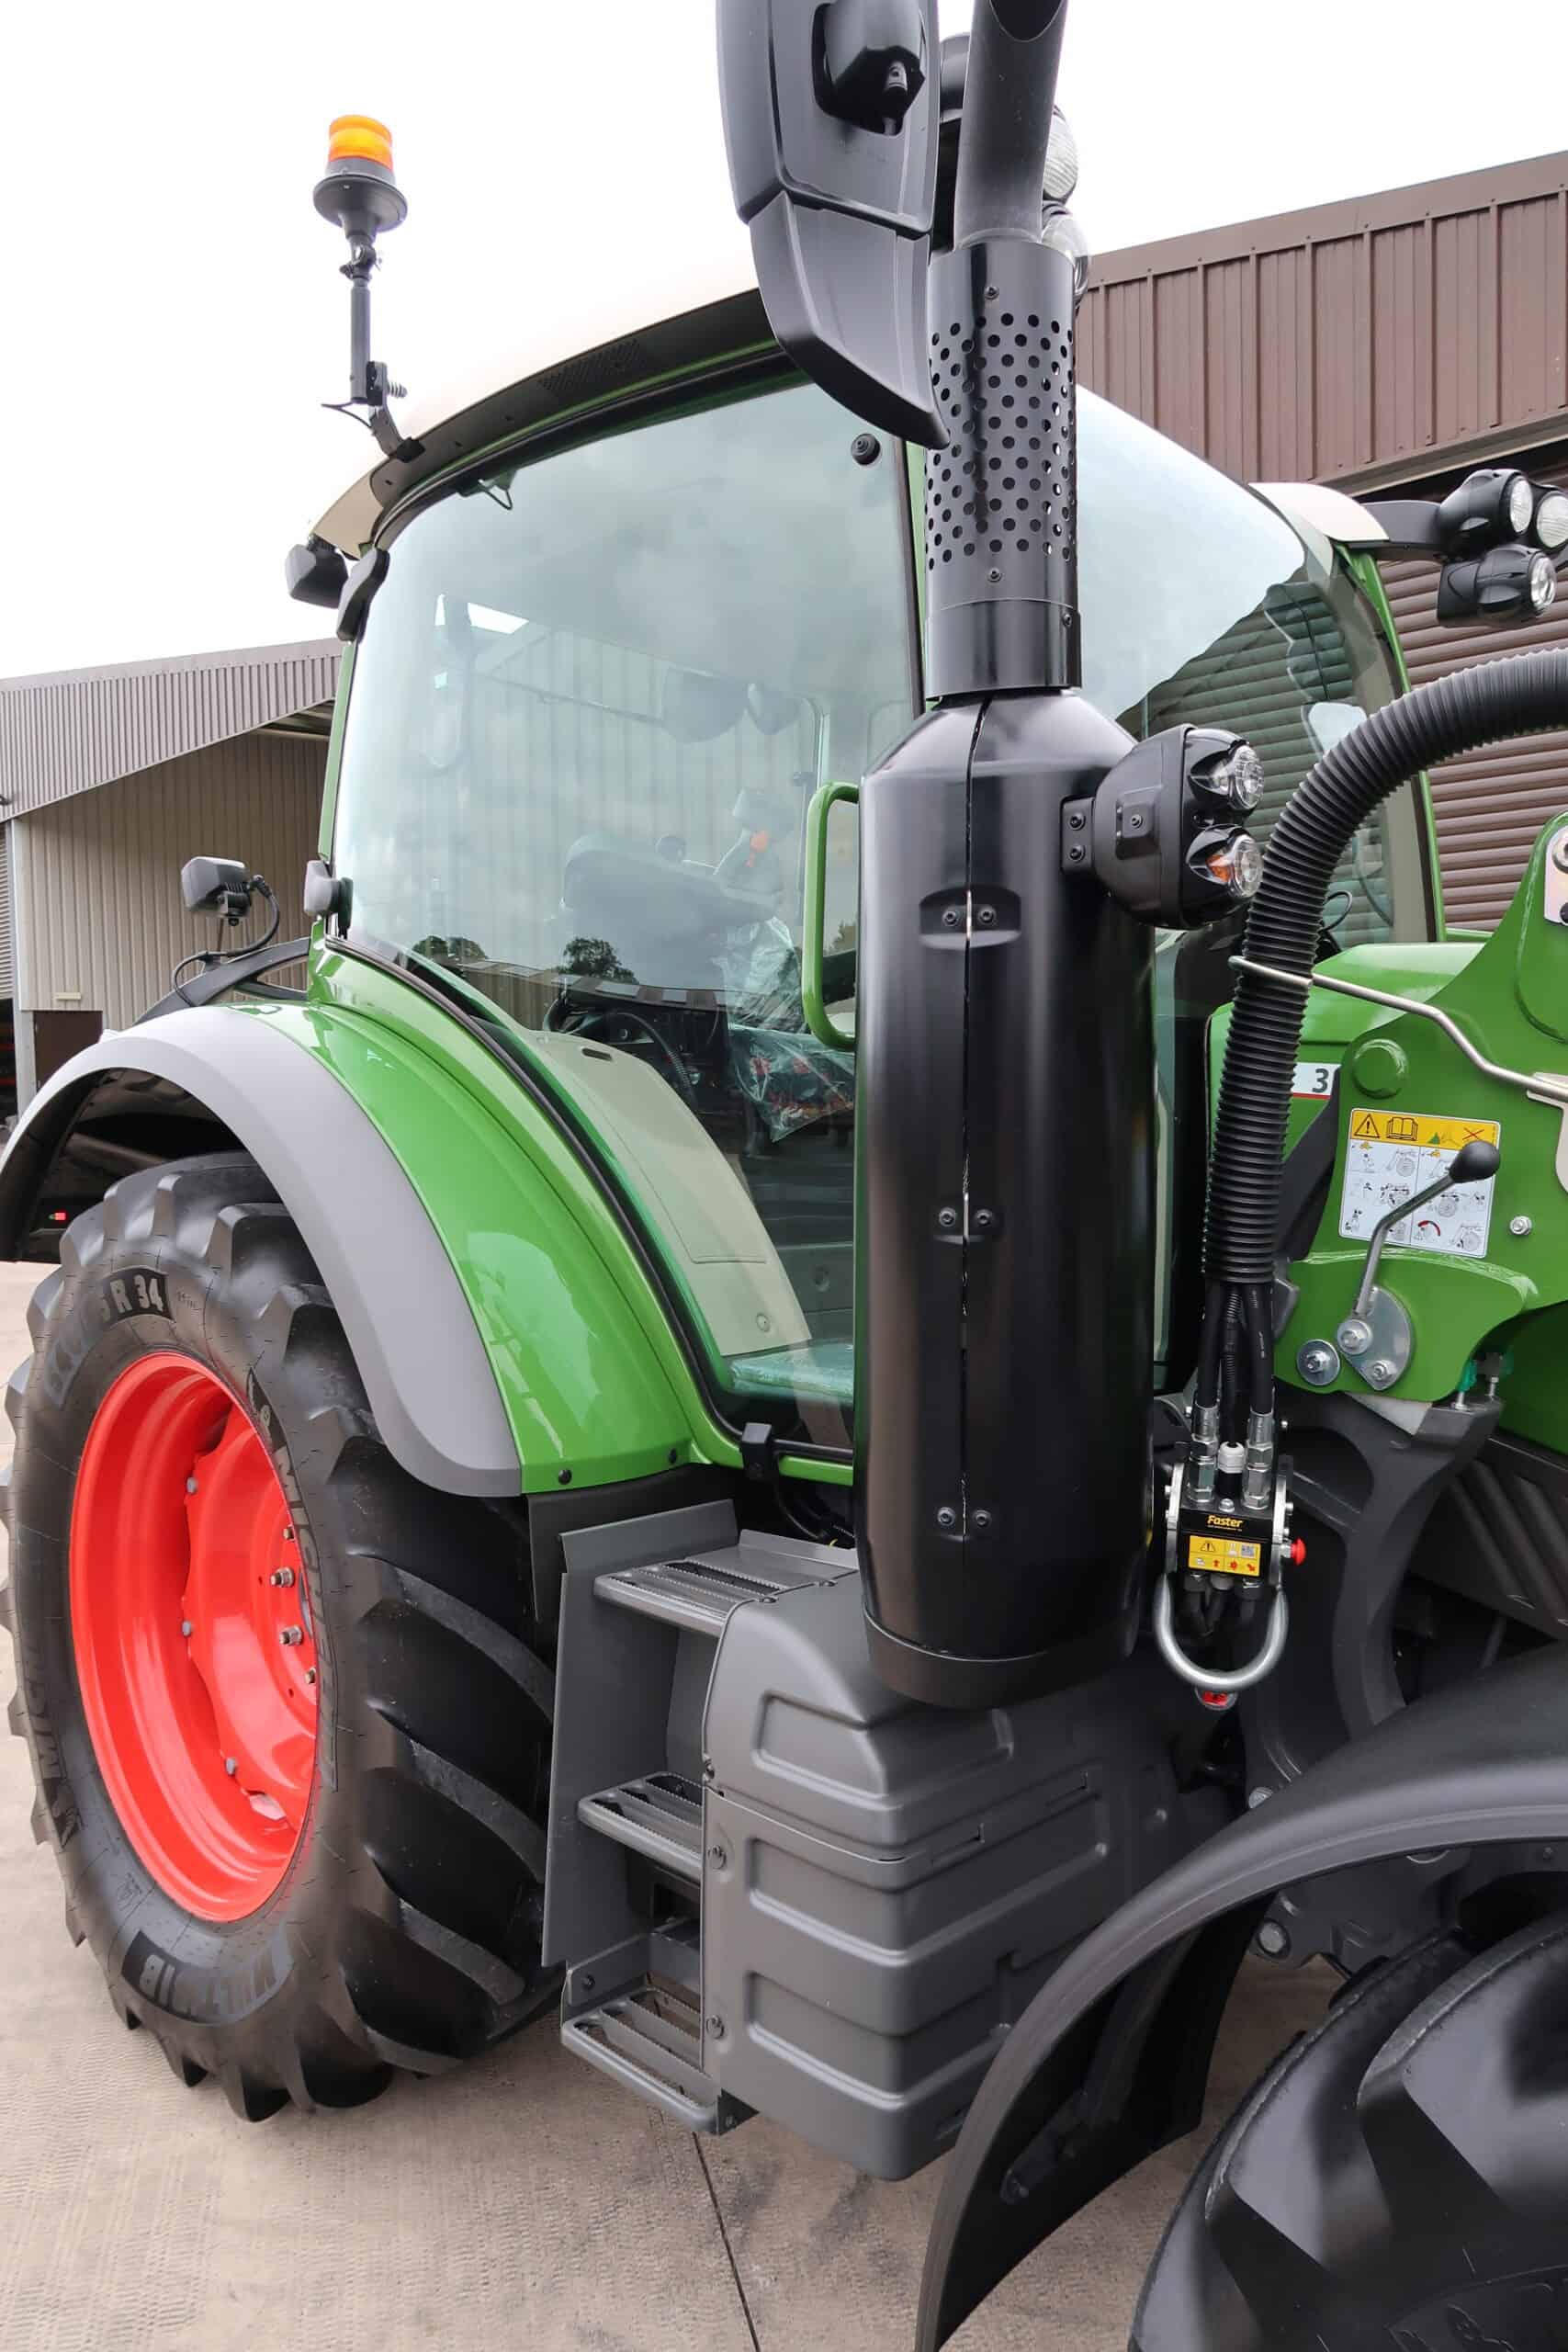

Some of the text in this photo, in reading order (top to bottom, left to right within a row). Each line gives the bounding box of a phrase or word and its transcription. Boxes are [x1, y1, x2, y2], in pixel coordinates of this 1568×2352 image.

[109, 1278, 133, 1314] R
[134, 1273, 164, 1313] 34
[1207, 1514, 1244, 1528] Faster
